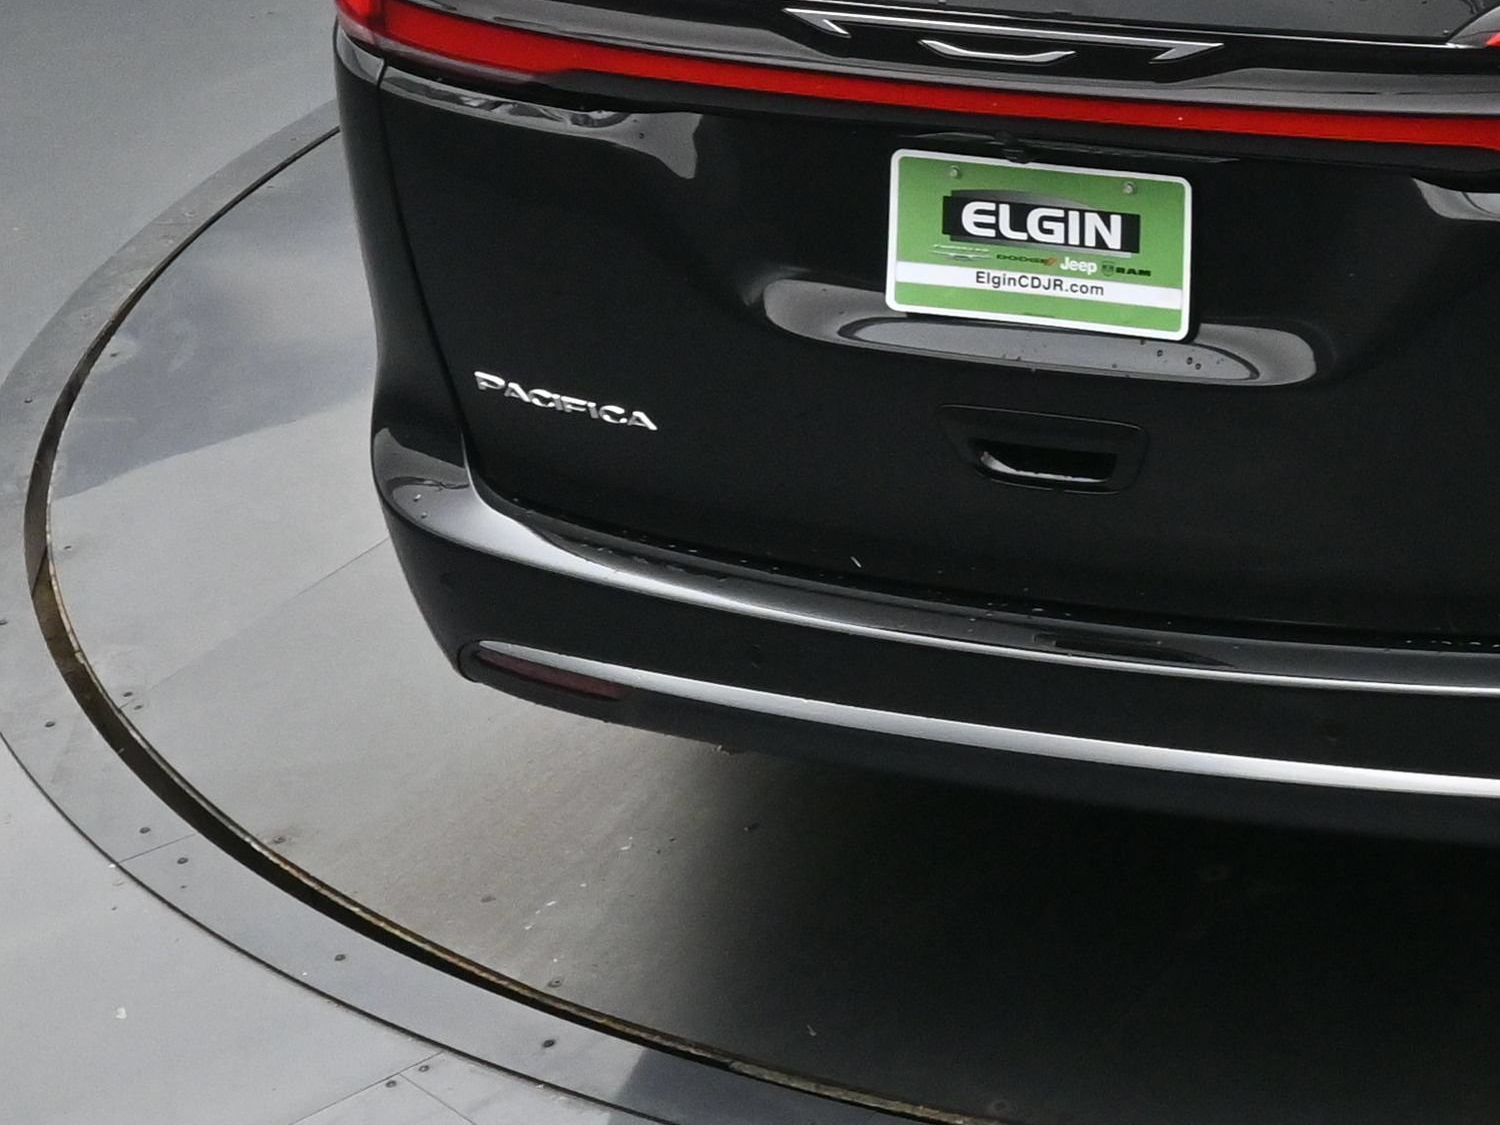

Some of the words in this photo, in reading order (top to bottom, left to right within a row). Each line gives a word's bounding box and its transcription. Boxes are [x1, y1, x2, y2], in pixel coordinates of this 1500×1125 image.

[961, 201, 1123, 250] ELGIN
[975, 271, 1104, 296] ElginCDJR.com
[1060, 256, 1098, 275] Jeep
[1115, 267, 1151, 277] RAM
[473, 371, 658, 431] PACIFICA
